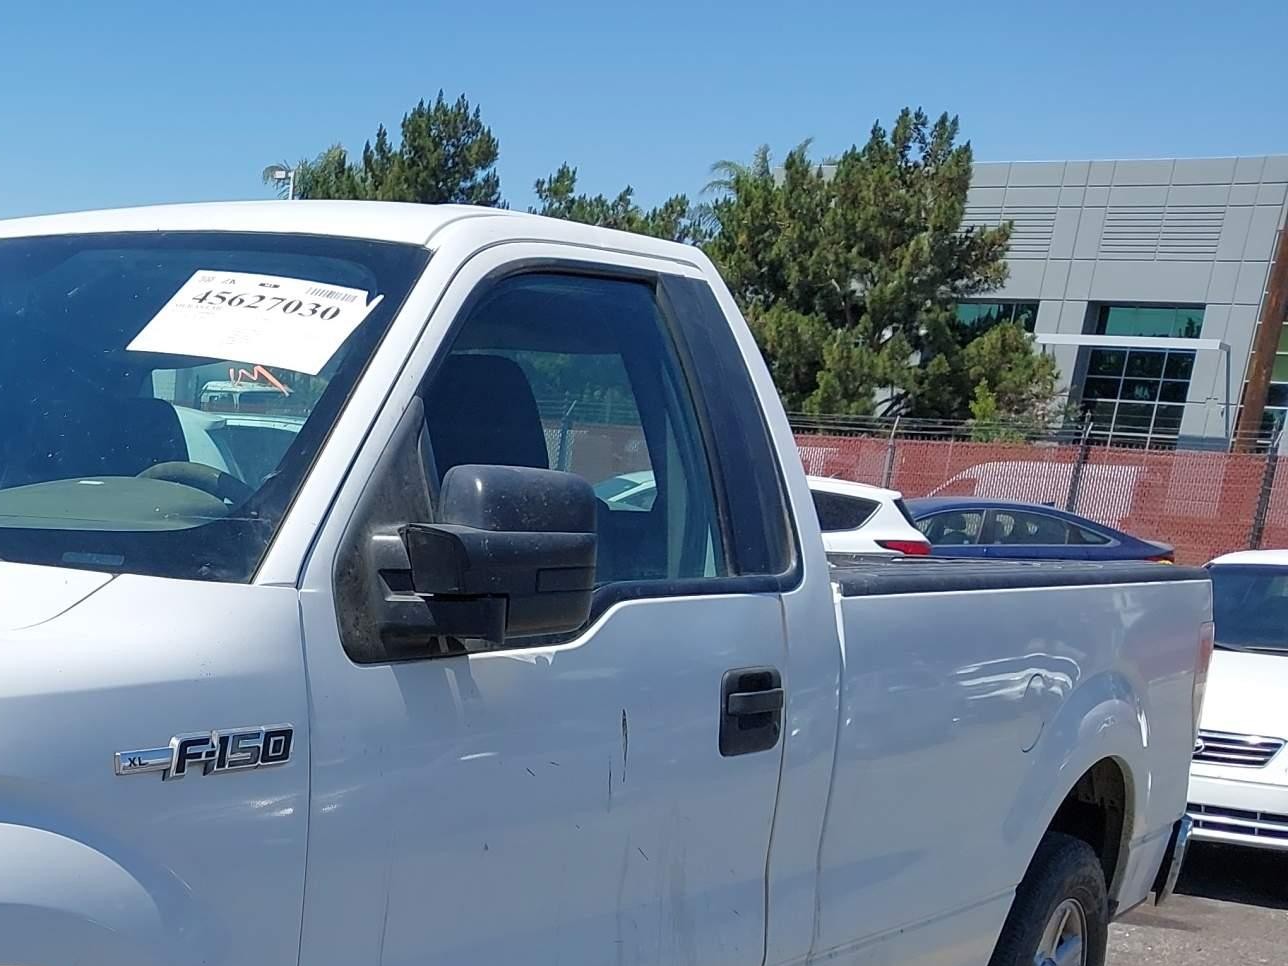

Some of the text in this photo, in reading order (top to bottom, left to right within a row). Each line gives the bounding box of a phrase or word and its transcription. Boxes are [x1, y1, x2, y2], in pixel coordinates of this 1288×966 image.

[192, 289, 340, 320] 45627030
[127, 723, 295, 776] XL F-150
